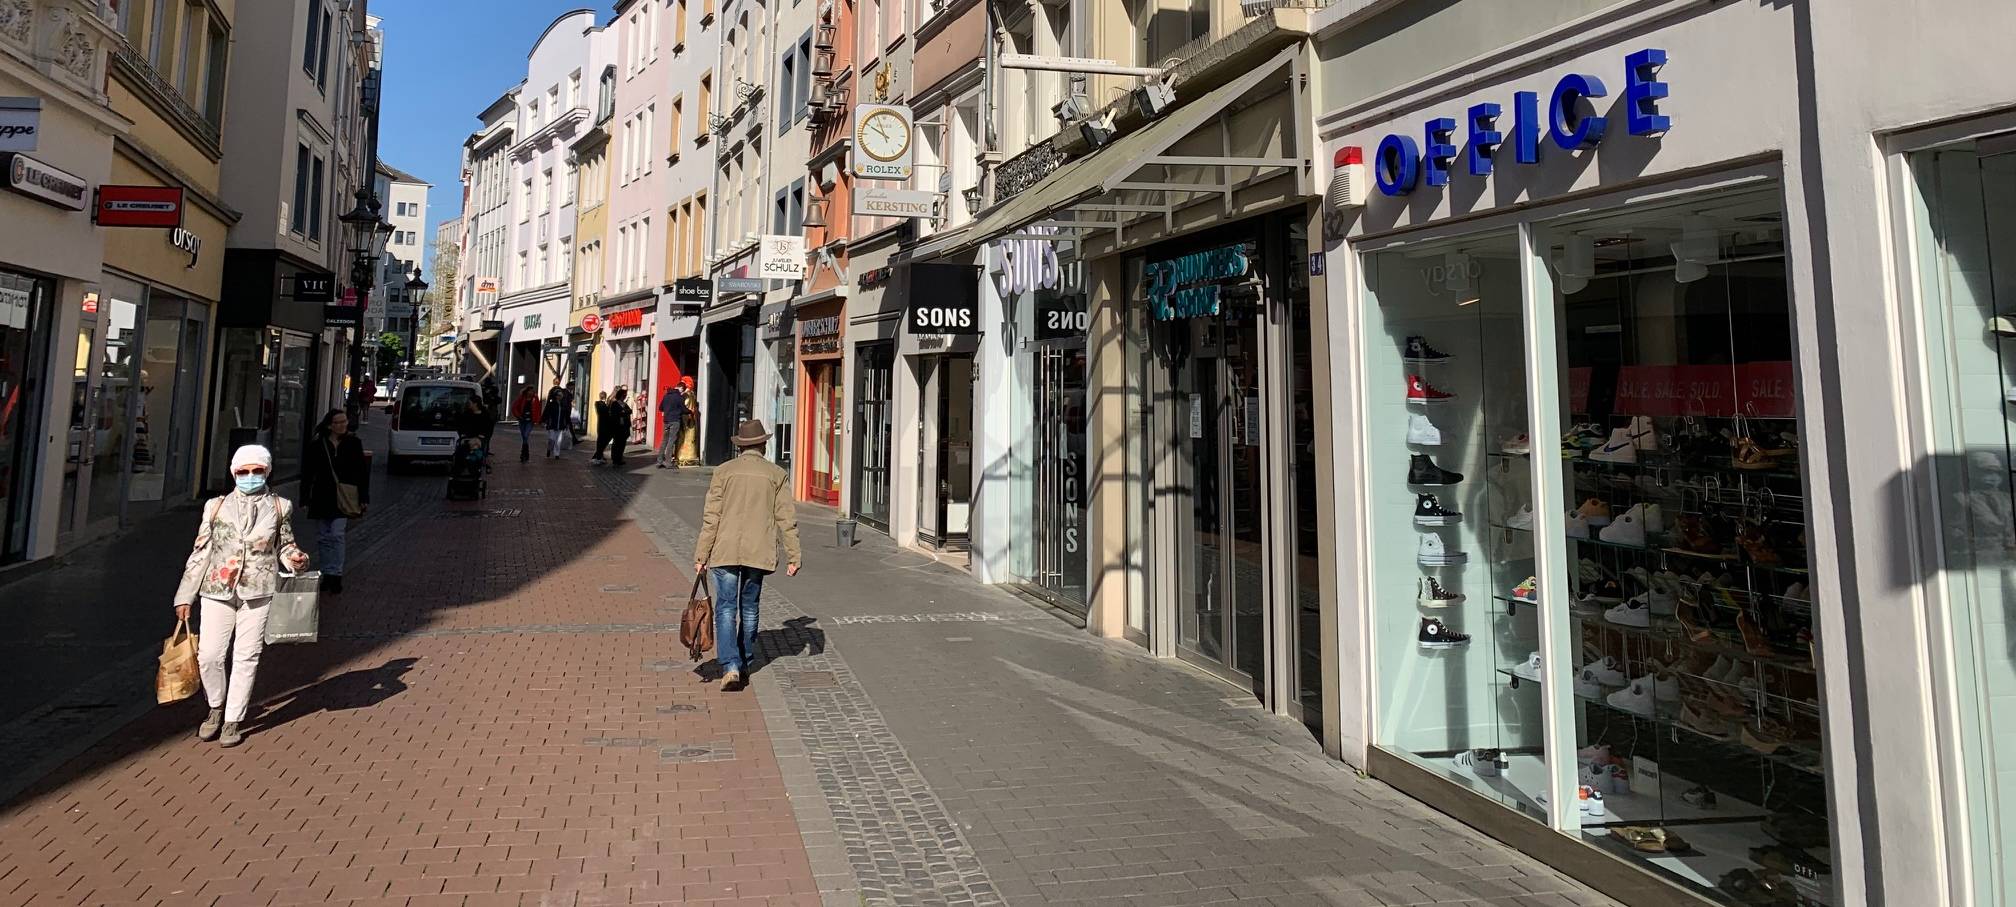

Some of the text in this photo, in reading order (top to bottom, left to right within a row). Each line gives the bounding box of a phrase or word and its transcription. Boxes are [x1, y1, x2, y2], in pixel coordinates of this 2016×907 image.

[1375, 48, 1673, 197] OFFICE
[26, 166, 41, 185] LE
[866, 165, 901, 174] ROLEX
[866, 200, 928, 213] KERSTING
[1325, 210, 1344, 240] 32
[173, 228, 202, 269] orsay
[1000, 218, 1059, 298] SONS
[764, 262, 800, 273] SCHULZ
[1311, 255, 1323, 274] 34
[303, 280, 328, 290] VIU
[481, 279, 495, 289] dm
[678, 286, 710, 295] shoe box
[916, 307, 971, 327] SONS
[1065, 451, 1079, 553] SONS
